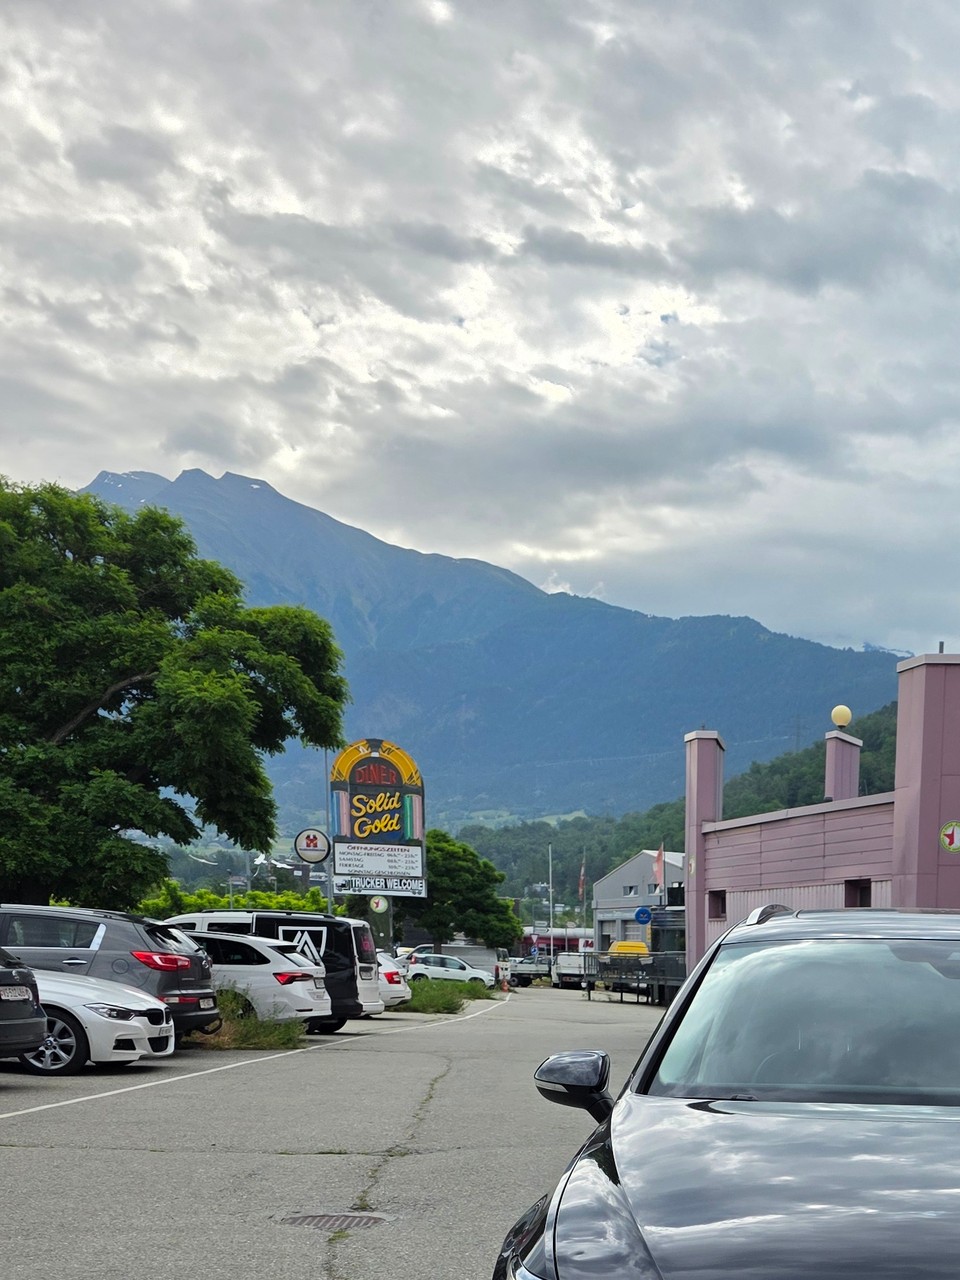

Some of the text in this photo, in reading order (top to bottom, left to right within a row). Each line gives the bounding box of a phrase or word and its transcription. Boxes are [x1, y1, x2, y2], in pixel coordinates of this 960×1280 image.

[355, 764, 397, 785] DINER
[351, 792, 402, 817] Solid
[354, 813, 401, 838] Gold
[351, 876, 423, 891] TRUCKER WELCOME
